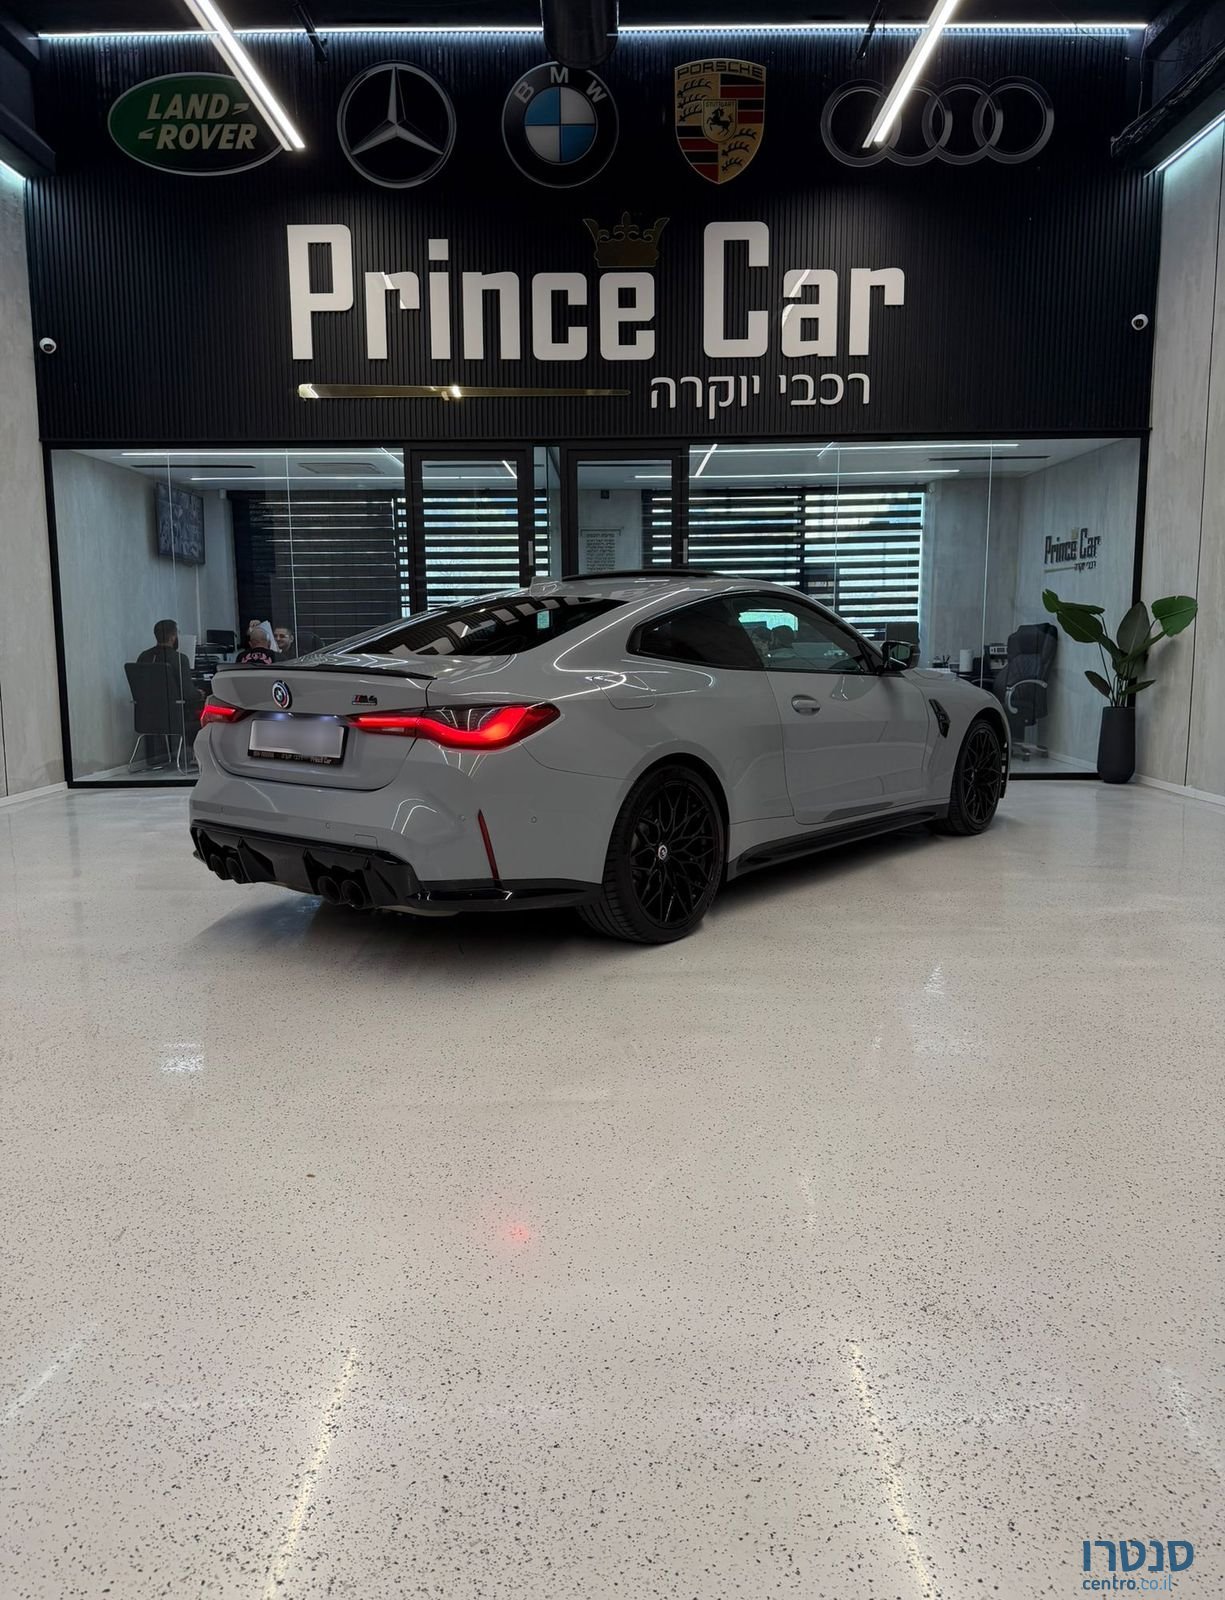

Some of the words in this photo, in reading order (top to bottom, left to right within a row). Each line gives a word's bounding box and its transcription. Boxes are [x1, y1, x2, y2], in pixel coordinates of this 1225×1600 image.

[513, 66, 608, 104] BMW
[677, 61, 764, 80] PORSCHE
[146, 93, 230, 120] LAND
[156, 123, 258, 150] ROVER
[286, 223, 656, 362] Prince
[703, 220, 906, 359] Car
[650, 374, 761, 421] יוקרה
[778, 372, 871, 407] רכבי
[1044, 535, 1078, 565] Prince
[1079, 527, 1102, 560] Car
